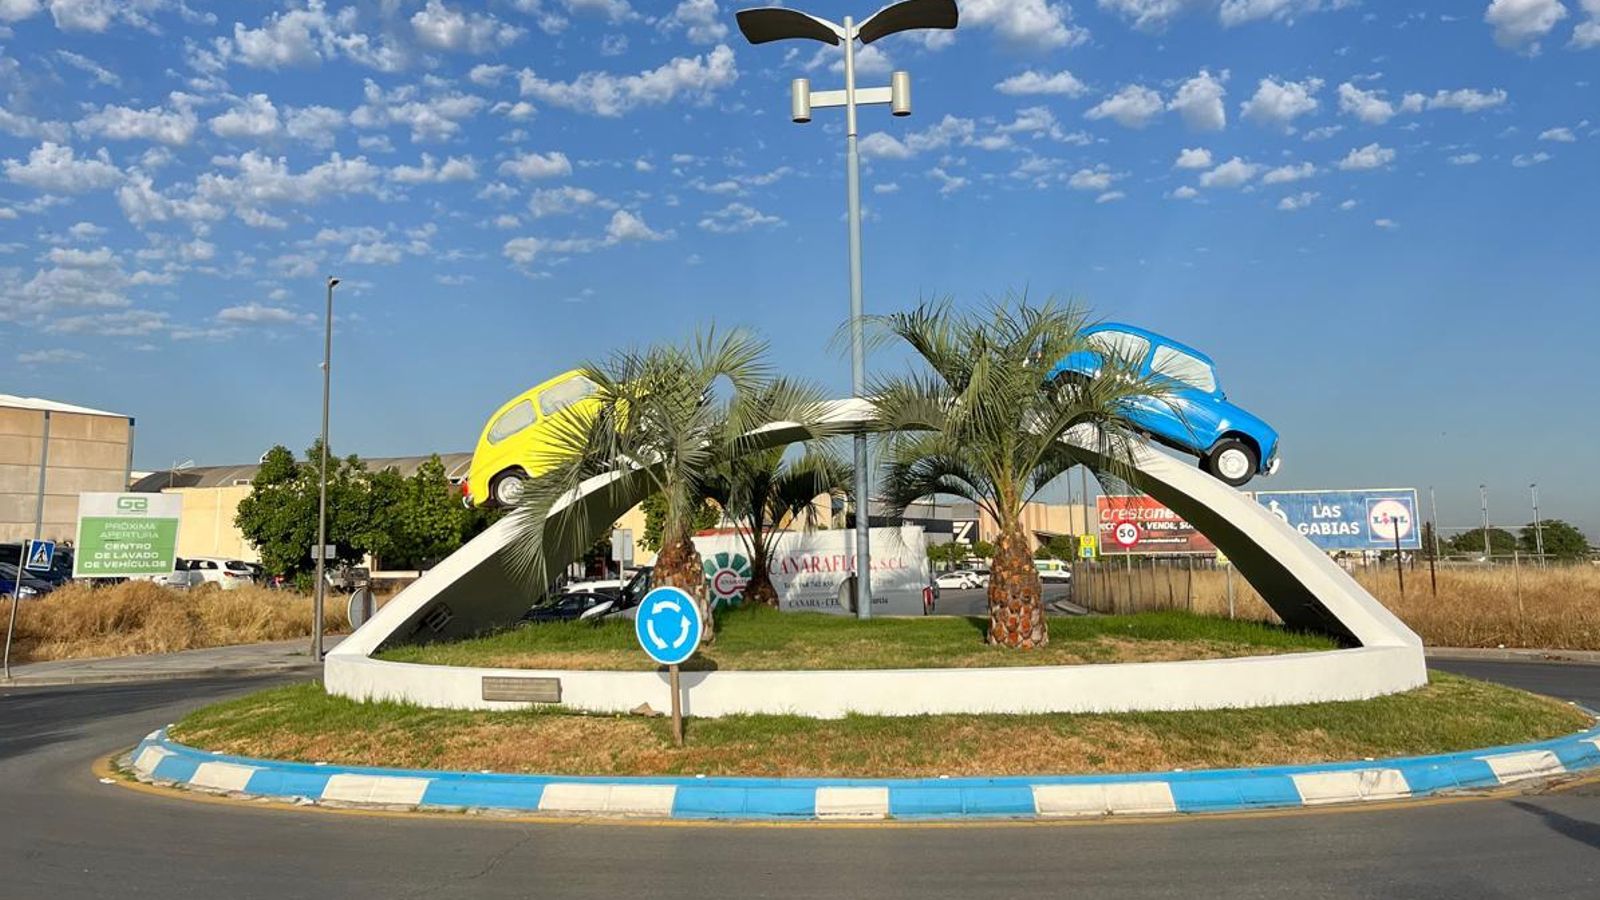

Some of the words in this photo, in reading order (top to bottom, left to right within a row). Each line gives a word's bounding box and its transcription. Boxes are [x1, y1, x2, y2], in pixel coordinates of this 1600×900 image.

[1101, 506, 1181, 520] crestane
[1312, 505, 1341, 518] LAS
[104, 521, 156, 530] PRÓXIMA
[1297, 521, 1360, 535] GABIAS
[99, 531, 159, 539] APERTURA
[1119, 529, 1135, 538] 50
[104, 543, 151, 551] CENTRO
[94, 552, 111, 560] DE
[113, 551, 159, 560] LAVADO
[84, 561, 100, 569] DE
[103, 559, 167, 569] VEHÍCULOS
